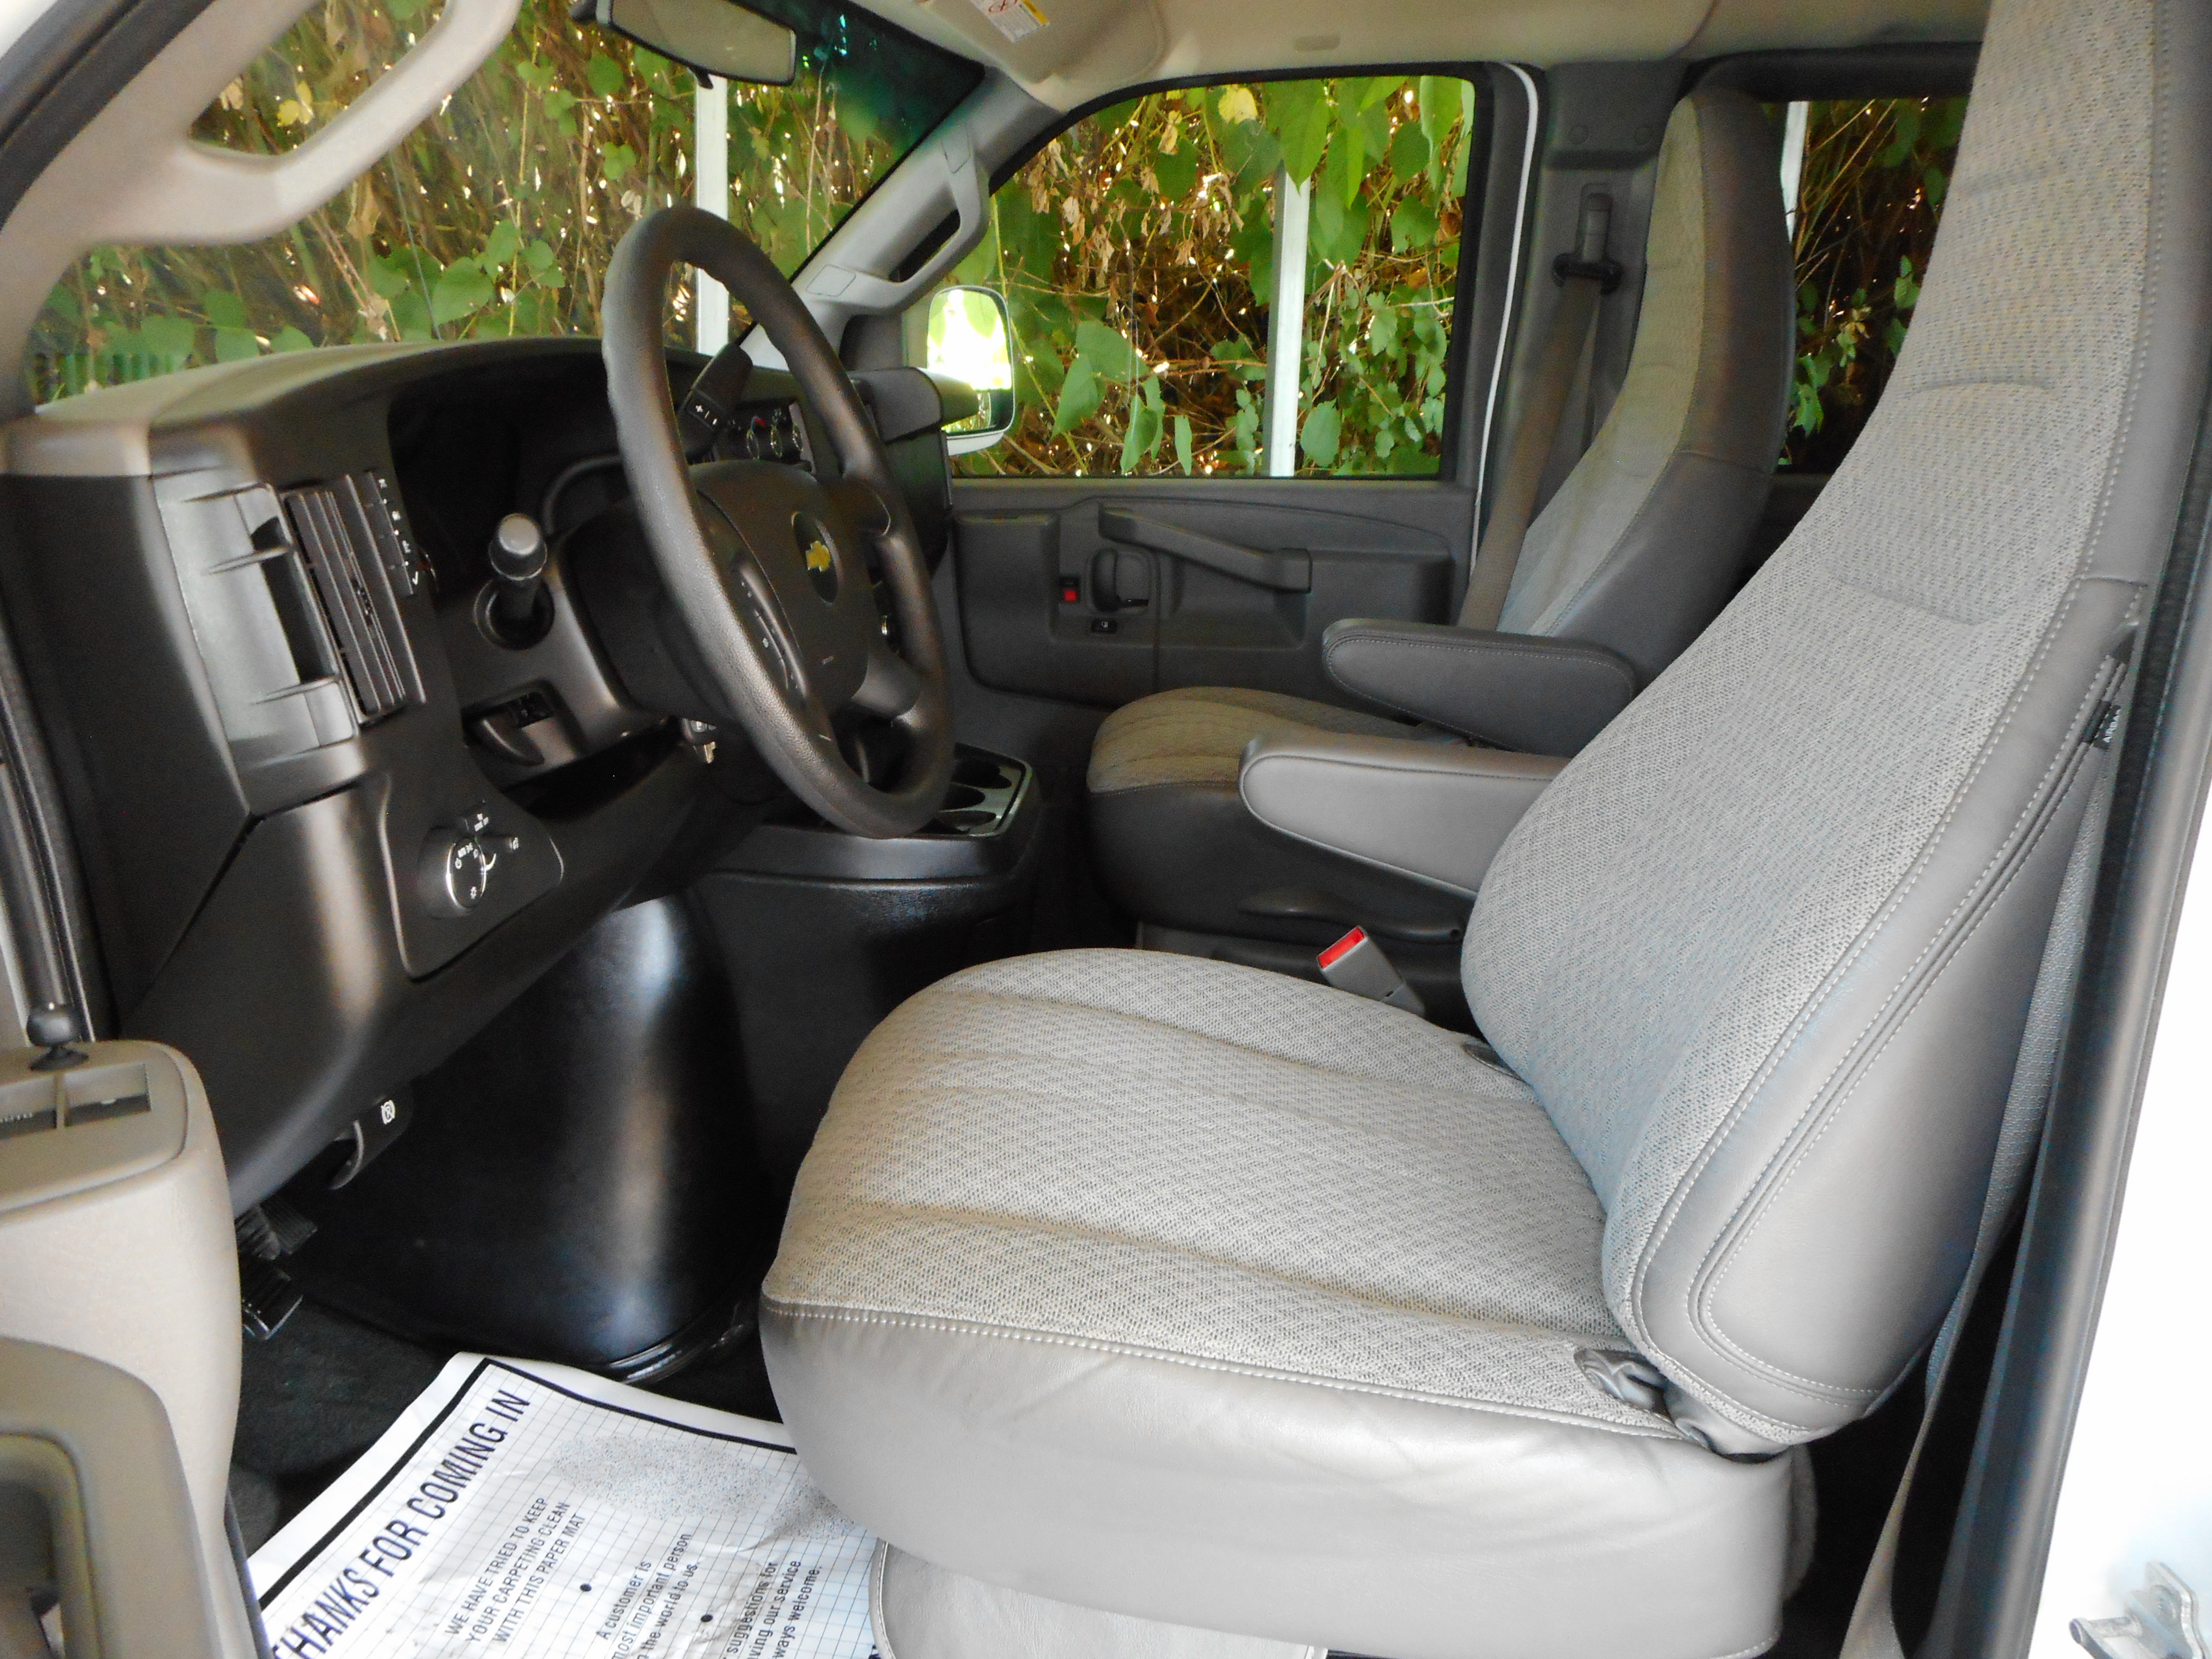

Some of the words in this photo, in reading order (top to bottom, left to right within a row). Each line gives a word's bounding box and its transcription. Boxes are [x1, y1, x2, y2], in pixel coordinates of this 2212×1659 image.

[358, 1519, 430, 1577] FOR
[406, 1422, 508, 1520] COMING
[485, 1389, 531, 1422] IN
[444, 1613, 470, 1634] WE
[461, 1577, 493, 1611] HAVE
[484, 1541, 517, 1574] TRIED
[510, 1525, 530, 1539] TO
[522, 1497, 548, 1524] KEEP
[465, 1606, 500, 1642] YOUR
[493, 1537, 545, 1604] CARPETING
[538, 1502, 571, 1536] CLEAN
[492, 1608, 524, 1642] WITH
[515, 1575, 544, 1604] THIS
[536, 1538, 570, 1574] PAPER
[562, 1512, 586, 1537] MAT
[596, 1630, 611, 1640] A
[605, 1574, 644, 1629] customer
[635, 1561, 652, 1572] is
[627, 1572, 670, 1630] important
[663, 1533, 692, 1571] person
[640, 1631, 662, 1650] the
[655, 1592, 681, 1627] world
[672, 1580, 689, 1592] to
[682, 1561, 701, 1577] us.
[726, 1580, 769, 1654] suggestions
[760, 1561, 779, 1578] for
[763, 1605, 781, 1625] our
[774, 1560, 802, 1603] service
[787, 1565, 823, 1621] welcome.
